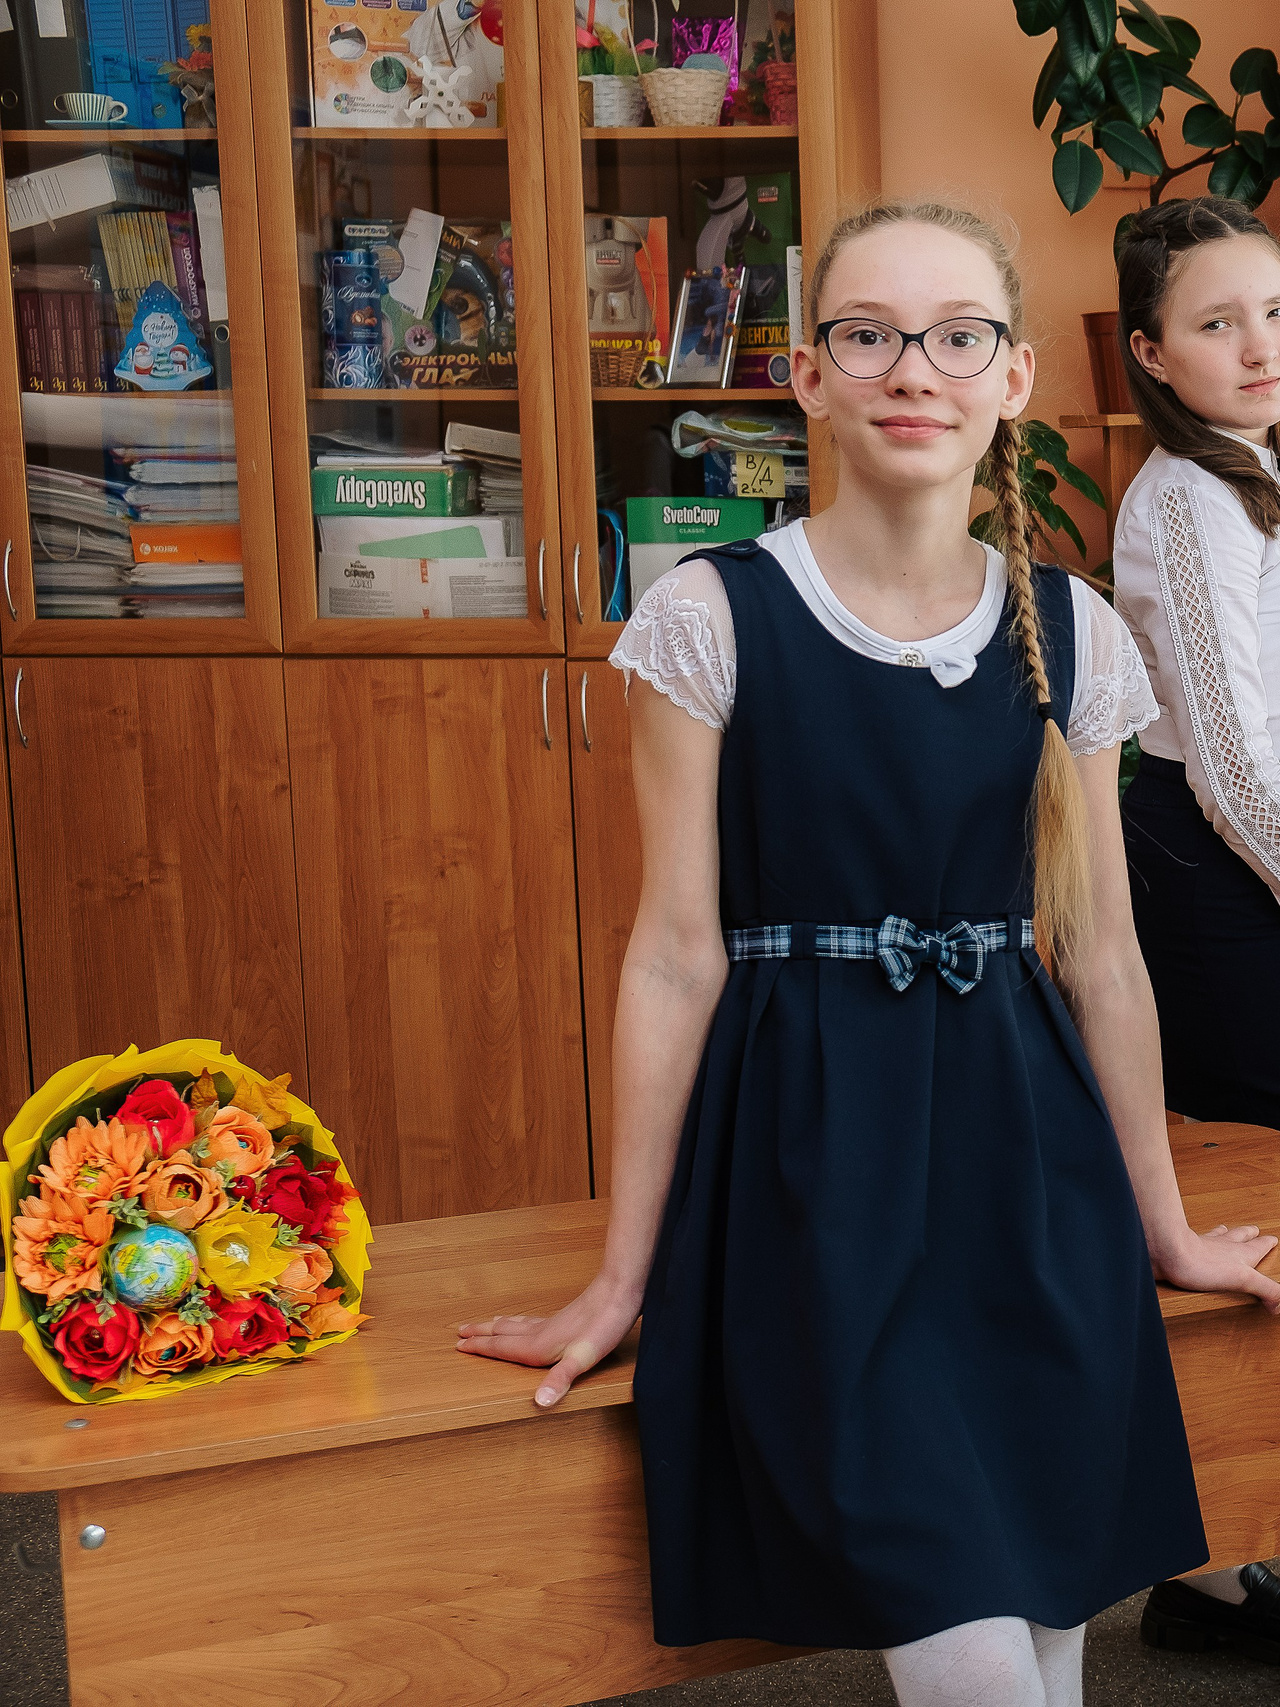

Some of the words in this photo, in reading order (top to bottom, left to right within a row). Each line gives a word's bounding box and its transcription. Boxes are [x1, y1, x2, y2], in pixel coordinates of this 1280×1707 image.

[183, 247, 199, 306] МИКРОСКОП
[740, 325, 790, 346] ВЕНГУКА
[402, 350, 517, 366] ЭЛЕКТРОННЫ
[335, 474, 426, 509] SvetoCopy
[662, 506, 721, 527] SvetoCopy
